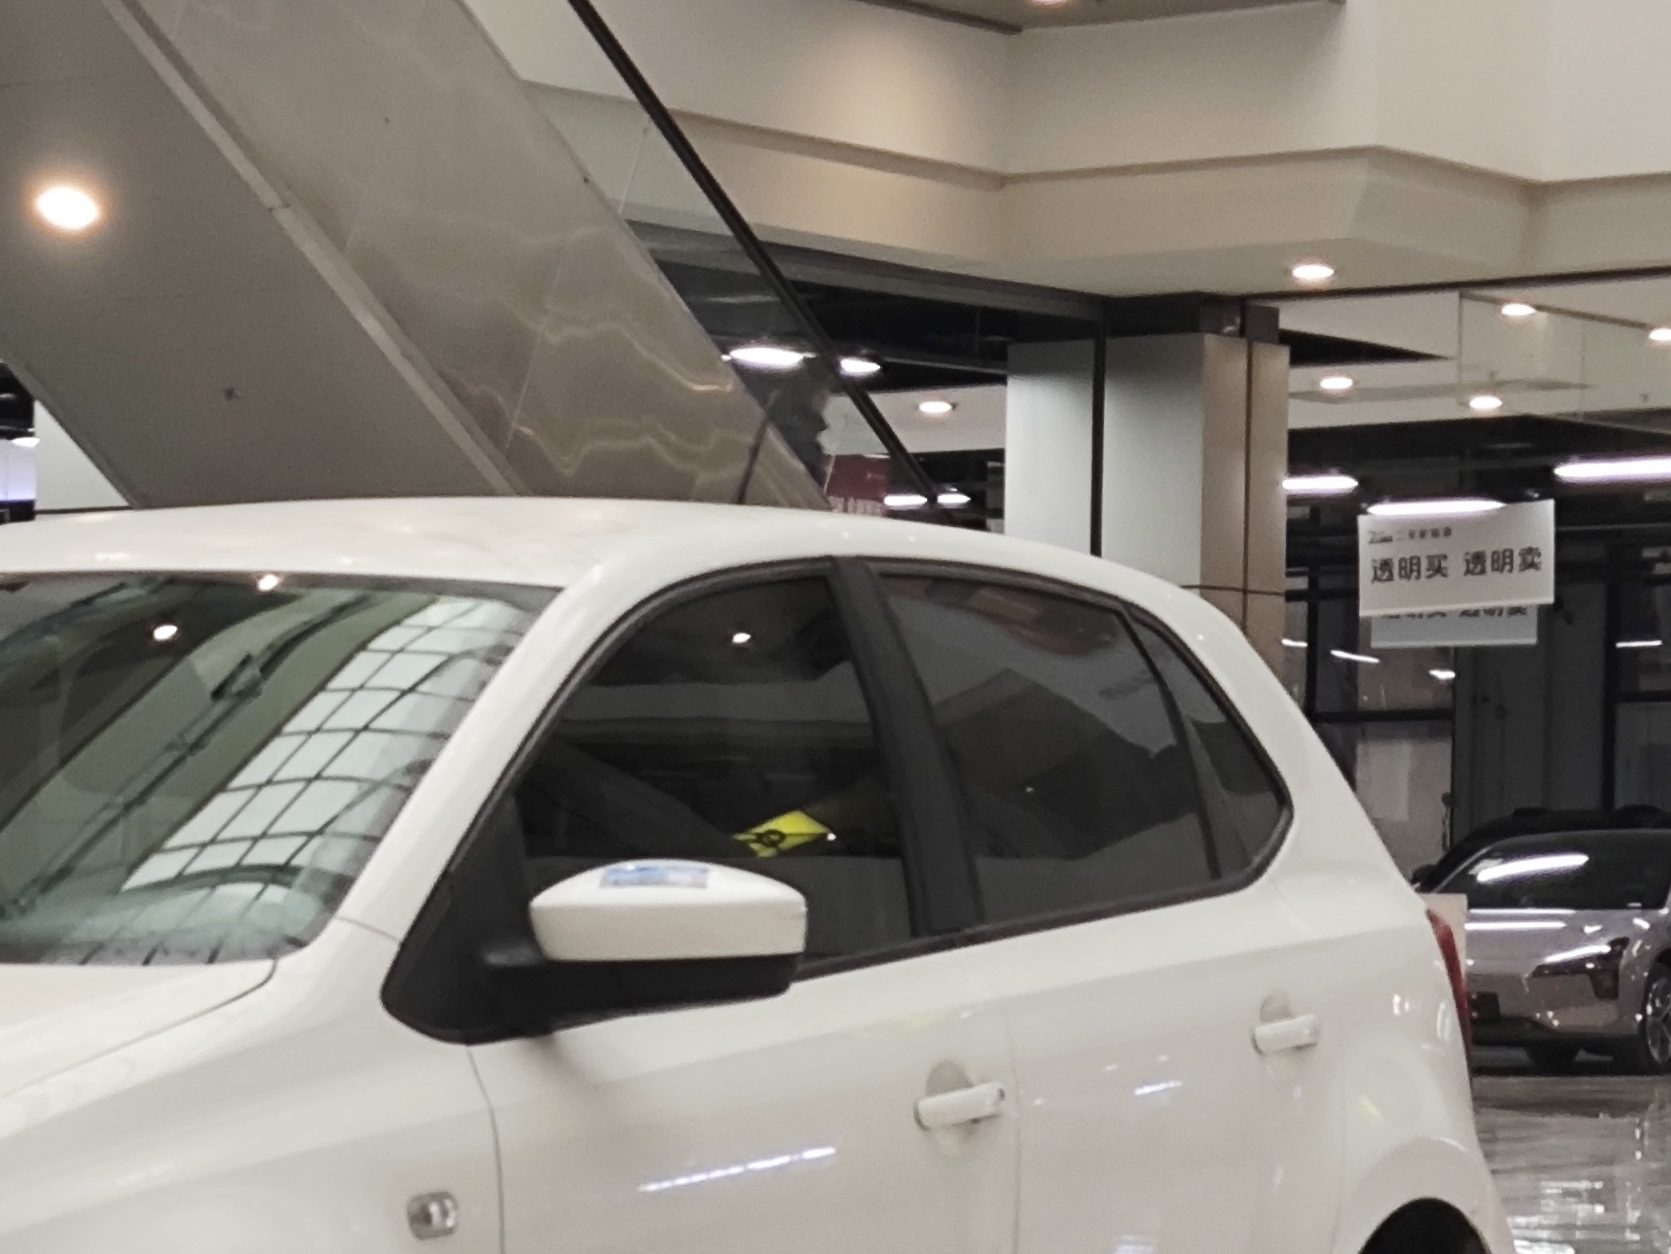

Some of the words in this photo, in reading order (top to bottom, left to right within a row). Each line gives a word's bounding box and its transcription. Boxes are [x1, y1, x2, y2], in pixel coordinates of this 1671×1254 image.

[1371, 553, 1449, 584] 透明买
[1463, 546, 1542, 577] 透明卖
